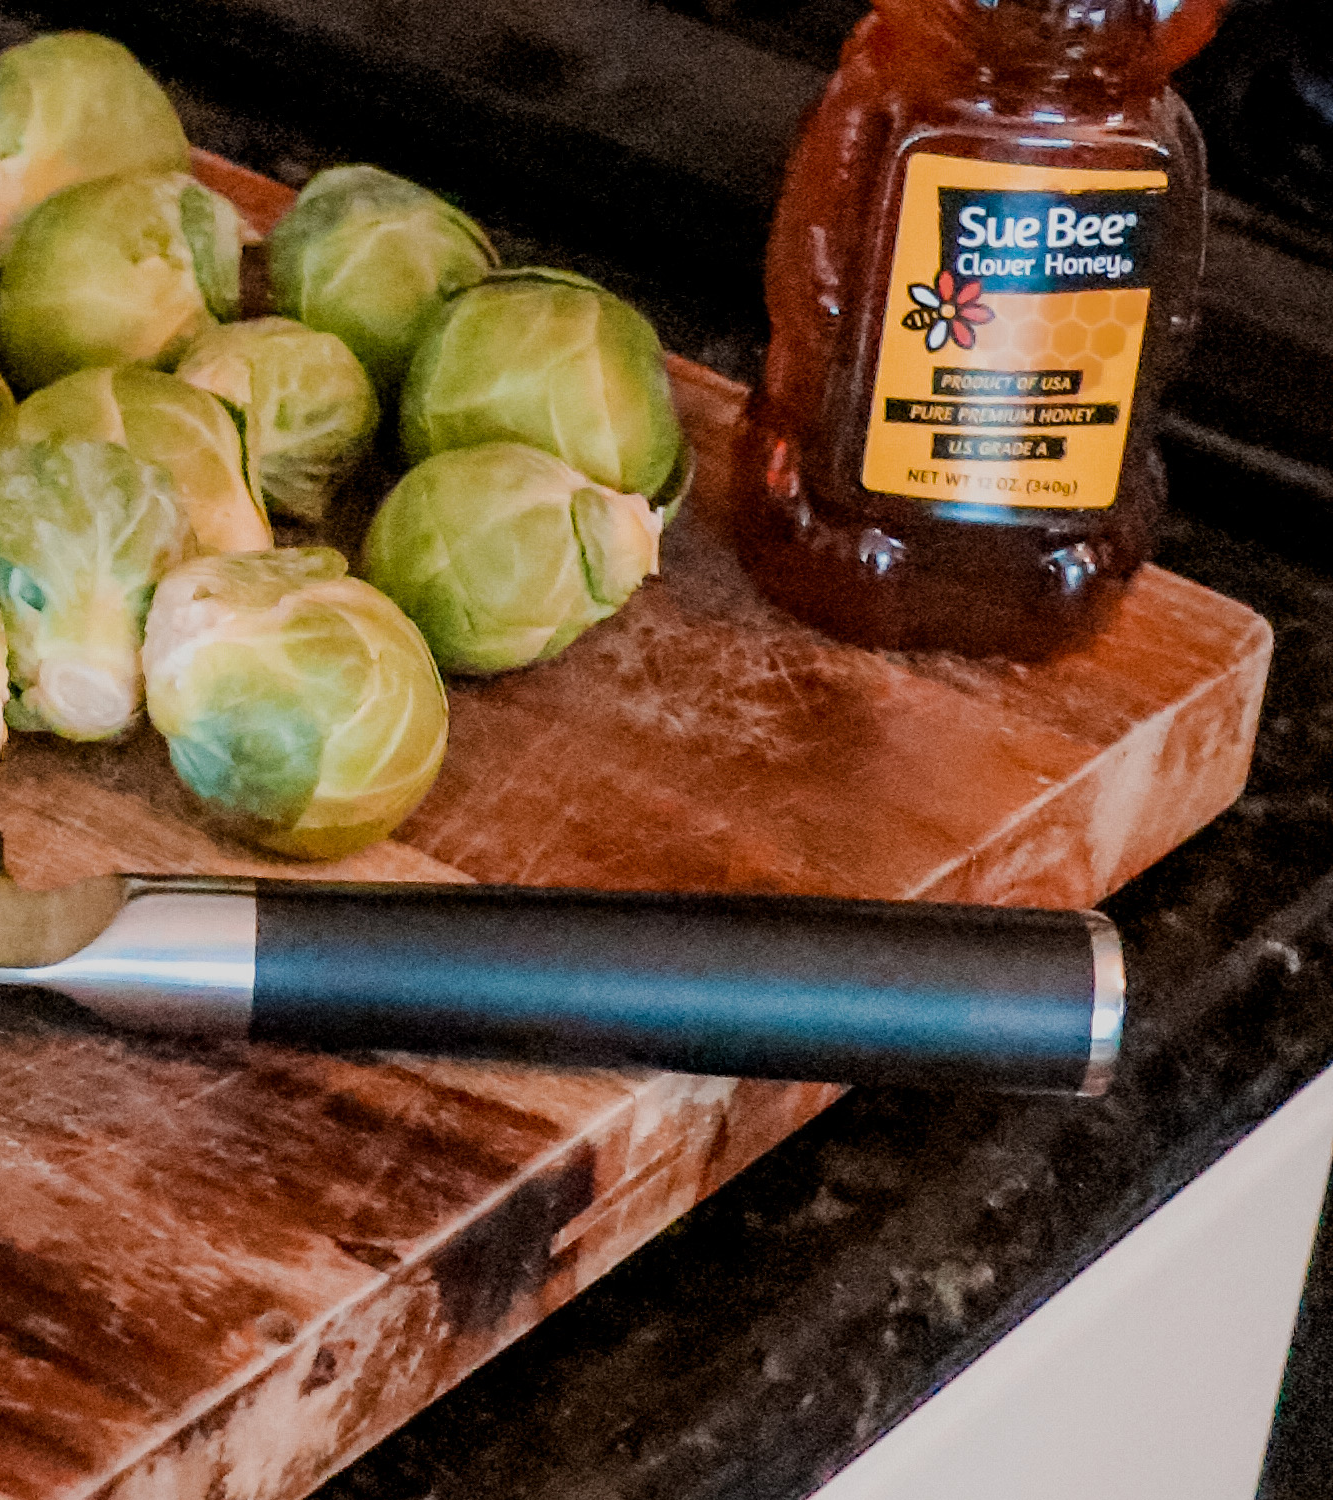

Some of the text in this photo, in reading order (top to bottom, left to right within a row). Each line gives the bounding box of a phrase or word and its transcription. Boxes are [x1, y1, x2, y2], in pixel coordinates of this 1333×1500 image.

[957, 206, 1126, 248] Sue Bee
[957, 252, 1122, 278] Clover Honey
[940, 373, 1072, 390] PRODUCT OF USA
[909, 404, 1096, 423] PURE PREMIUM HONEY
[978, 440, 1033, 456] GRADE
[1035, 442, 1048, 456] A
[907, 468, 939, 485] NET
[1026, 479, 1077, 496] (340g)
